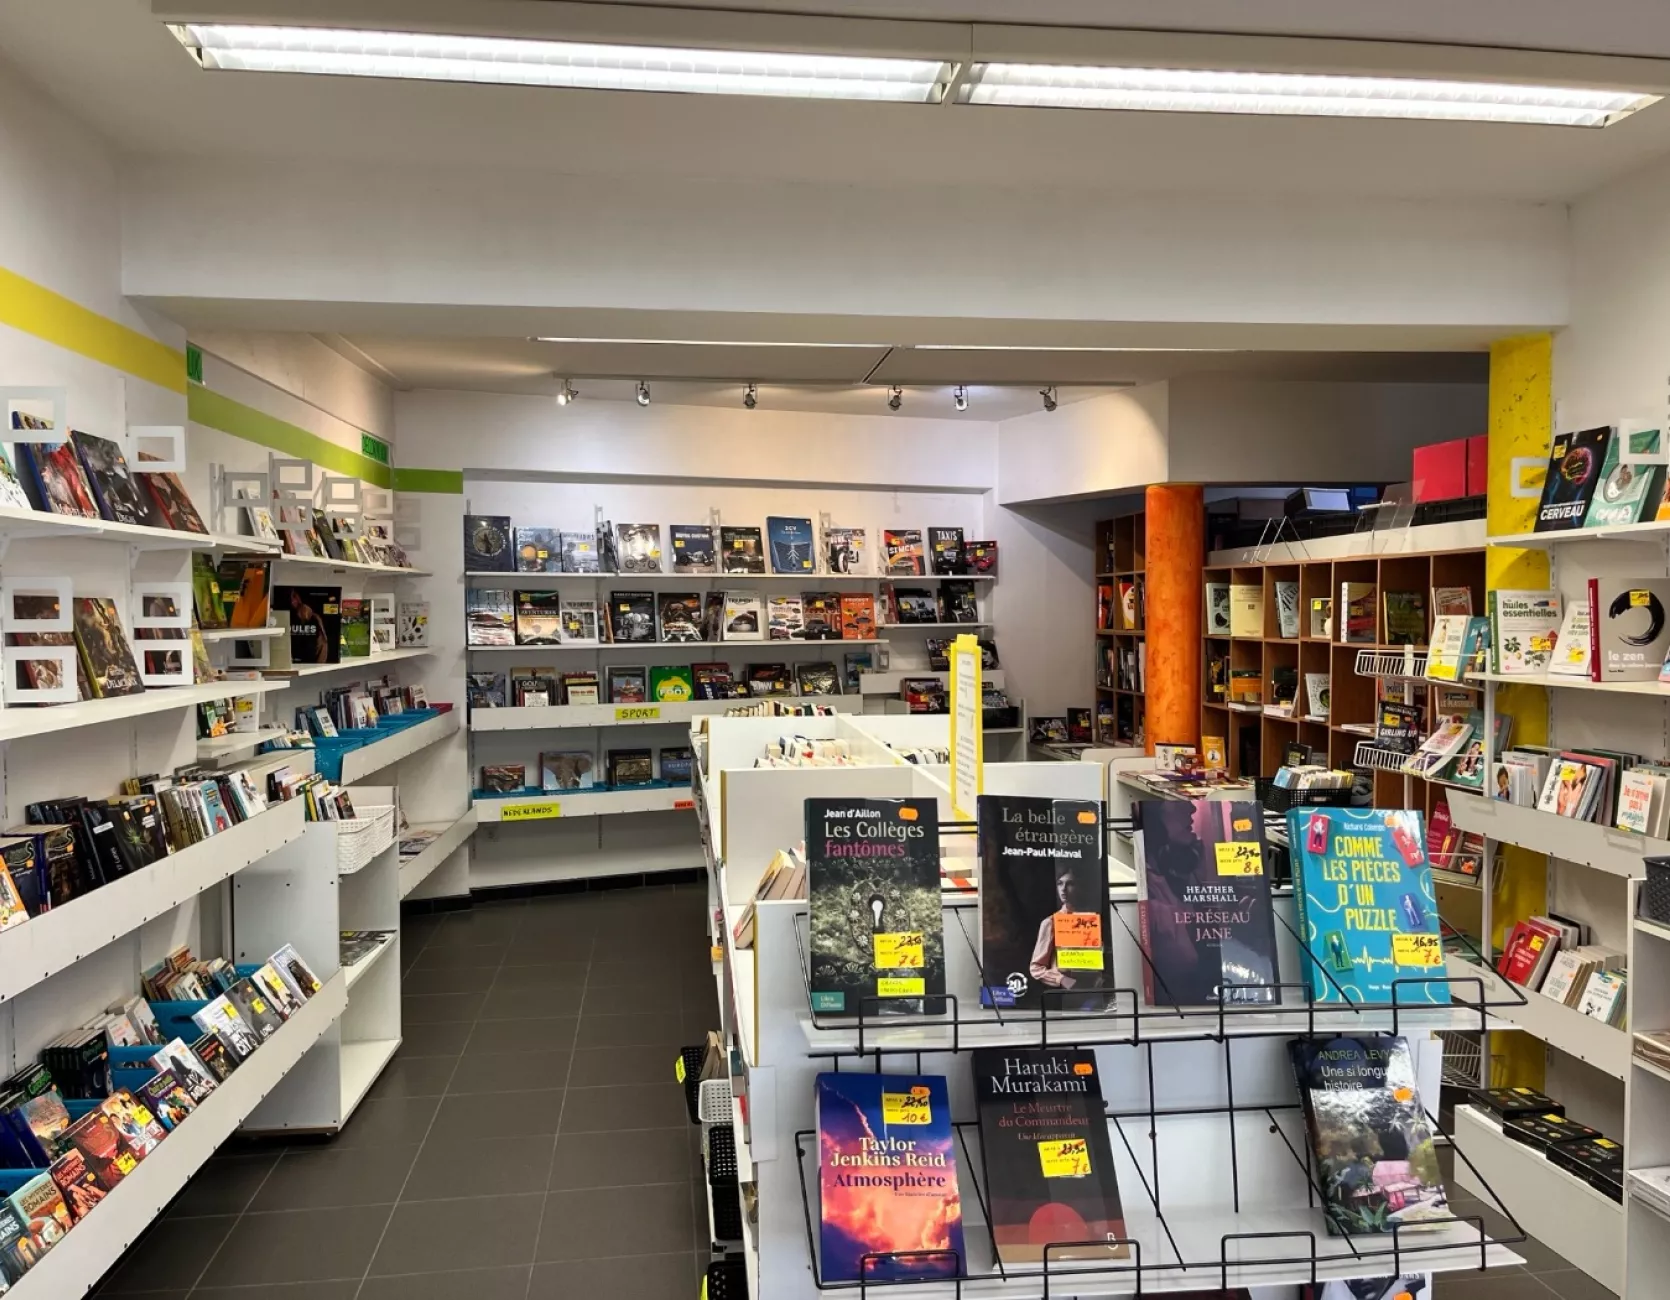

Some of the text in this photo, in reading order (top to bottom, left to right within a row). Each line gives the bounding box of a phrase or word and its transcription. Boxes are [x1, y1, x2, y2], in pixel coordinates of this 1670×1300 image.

[1541, 505, 1585, 520] CERVEAU
[936, 531, 958, 540] TAXIS
[889, 544, 914, 554] SIMCA
[1503, 601, 1529, 609] huiles
[1503, 609, 1557, 617] essentielles
[1608, 650, 1645, 661] le zen
[621, 708, 656, 718] SPORT
[503, 806, 553, 817] NEDERLANDS
[824, 809, 881, 819] Jean d'Aillon
[1002, 807, 1066, 825] La belle
[825, 821, 925, 842] Les Collèges
[1014, 826, 1095, 847] étrangère
[825, 839, 906, 858] fantômes
[1002, 845, 1083, 859] Jean-Paul Malaval
[1334, 835, 1385, 858] COMME
[1243, 861, 1252, 873] 8
[1322, 857, 1402, 883] LES PIÈCES
[1185, 885, 1236, 895] HEATHER
[1337, 883, 1376, 906] D'UN
[1182, 894, 1239, 903] MARSHALL
[1174, 908, 1251, 924] LE RÉSEAU
[1345, 908, 1399, 932] PUZZLE
[1195, 927, 1233, 941] JANE
[1413, 937, 1439, 947] 16,95
[1424, 948, 1433, 964] 7
[1318, 1049, 1390, 1061] ANDREA LEVY
[1004, 1057, 1070, 1076] Haruki
[1321, 1063, 1388, 1079] Une si longu
[991, 1075, 1088, 1094] Murakami
[1324, 1080, 1363, 1092] histoire
[1013, 1102, 1073, 1114] Le Meurtre
[901, 1112, 918, 1123] 10
[998, 1116, 1089, 1128] du Commandeur
[859, 1136, 917, 1154] Taylor
[830, 1152, 947, 1167] Jenkins Reid
[832, 1171, 947, 1192] Atmosphère
[23, 1186, 58, 1214] ROMAINS
